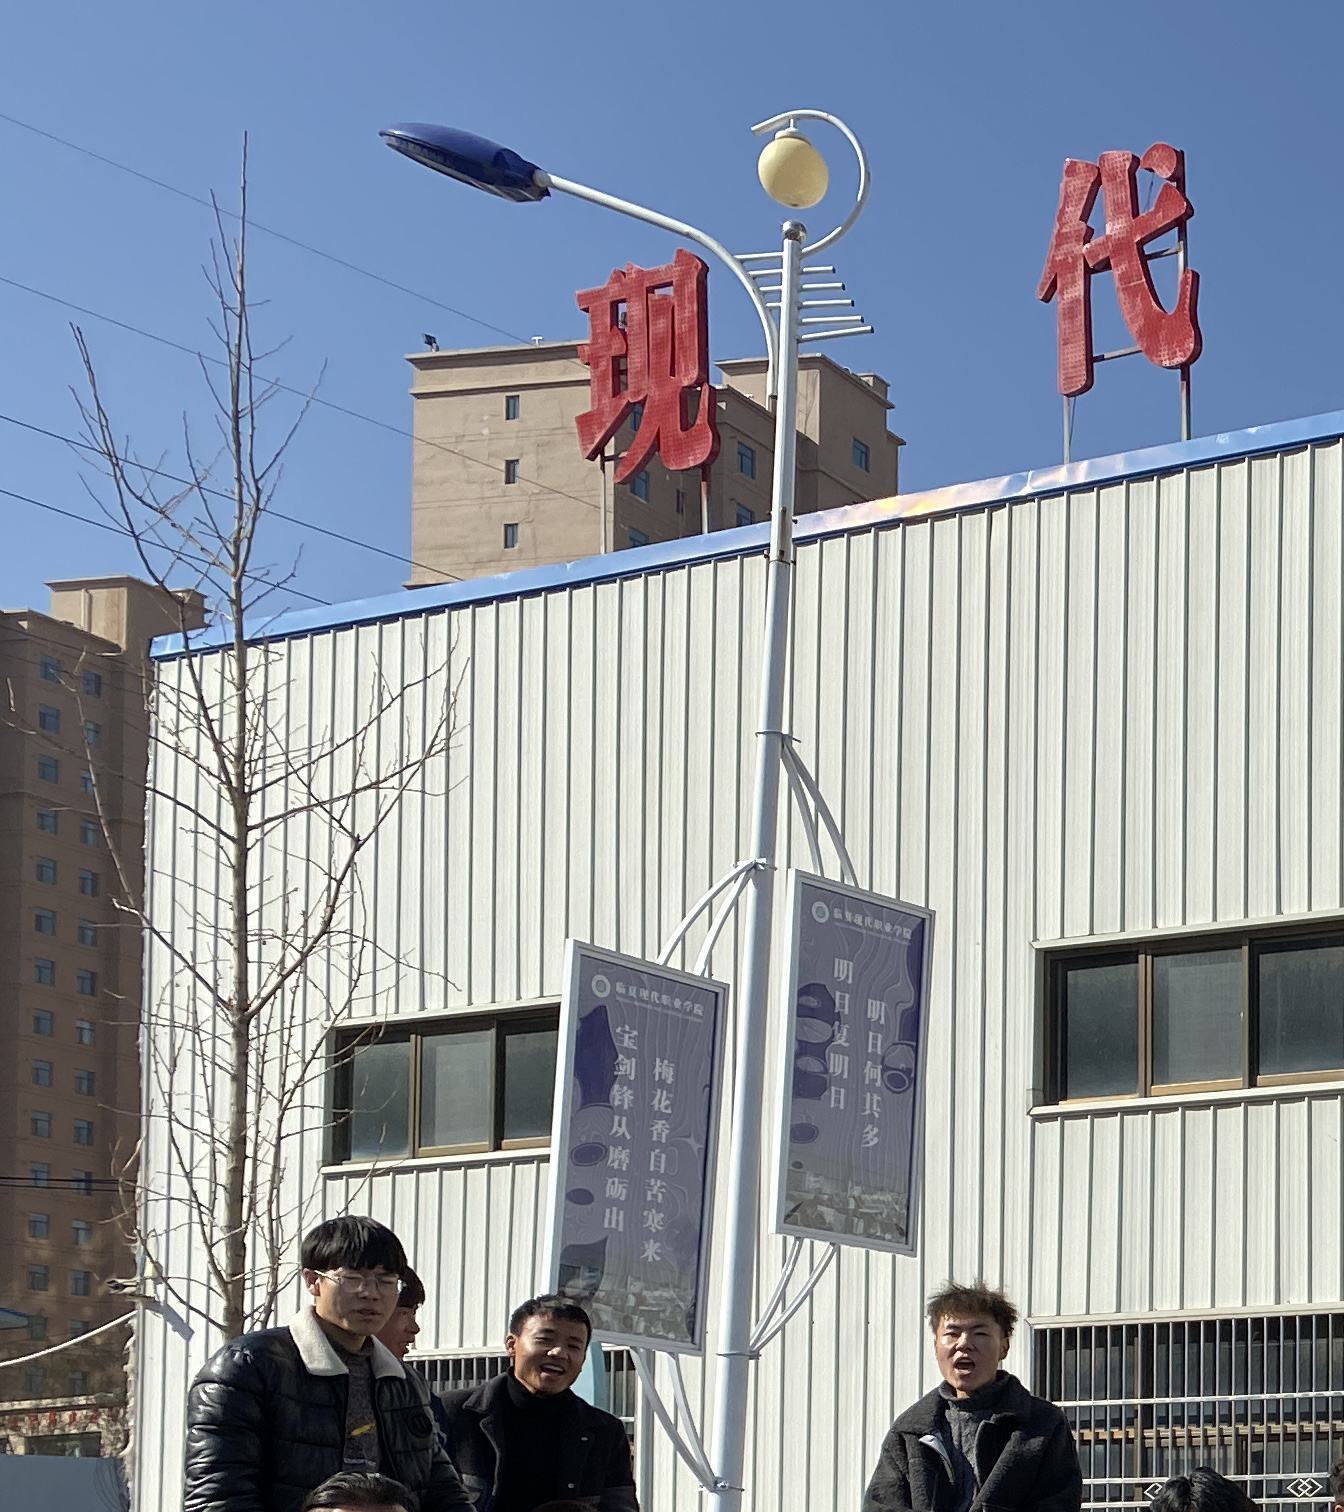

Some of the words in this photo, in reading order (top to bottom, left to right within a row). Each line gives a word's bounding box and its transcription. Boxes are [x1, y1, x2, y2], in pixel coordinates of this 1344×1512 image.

[829, 957, 854, 1110] 明日复明日
[861, 998, 886, 1148] 明日何其多
[603, 1024, 639, 1233] 宝剑锋从磨砺出
[640, 1057, 674, 1262] 梅花香自苦寒来
